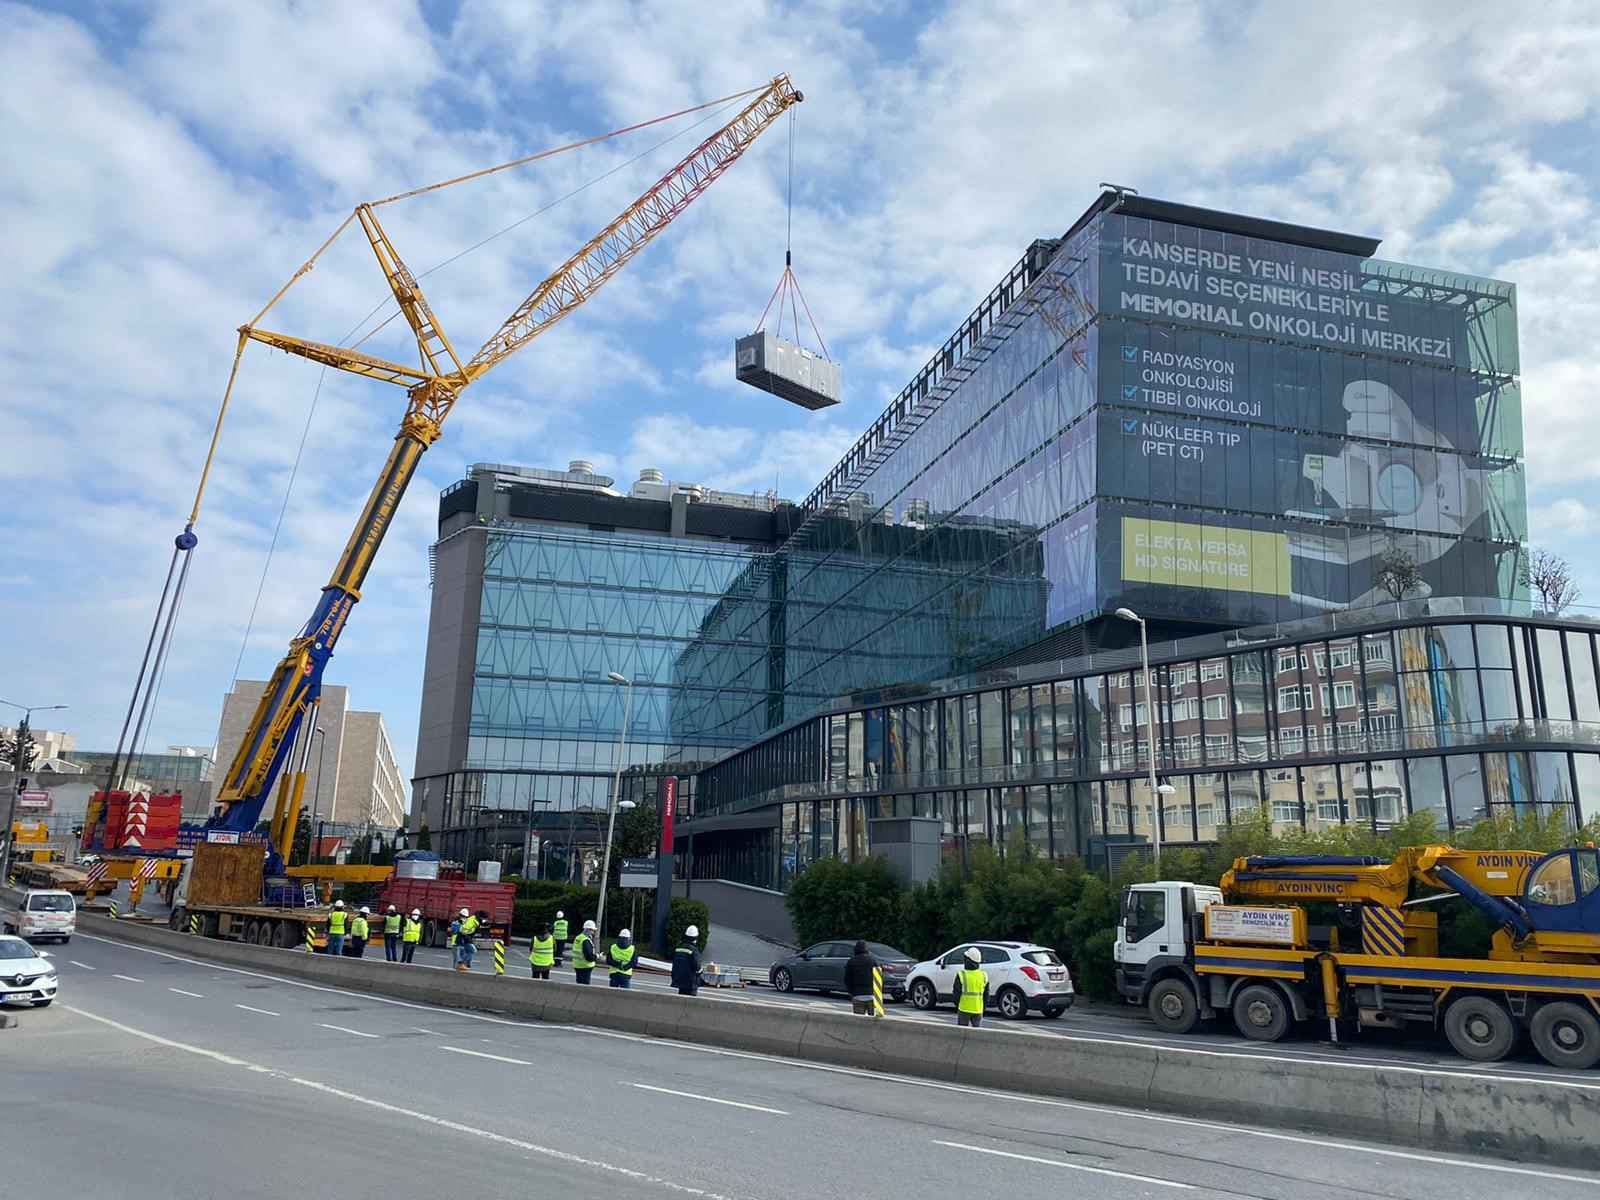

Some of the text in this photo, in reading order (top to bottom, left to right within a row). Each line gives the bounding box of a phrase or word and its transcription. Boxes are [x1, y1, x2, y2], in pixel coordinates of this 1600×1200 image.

[1122, 237, 1361, 293] KANSERDE YENİ NESİL
[1122, 263, 1390, 322] TEDAVİ SEÇENEKLERİYLE
[1120, 291, 1452, 359] MEMORIAL ONKOLOJİ MERKEZİ
[1142, 350, 1235, 375] RADYASYON
[1142, 369, 1233, 394] ONKOLOJİSİ
[1142, 388, 1262, 417] TIBBİ ONKOLOJİ
[1142, 421, 1240, 447] NÜKLEER TIP
[1142, 440, 1204, 462] (PET CT)
[1135, 555, 1158, 569] HD
[1477, 855, 1513, 868] AYDIN
[1278, 883, 1313, 893] AYDIN
[1241, 911, 1267, 920] AYDIN
